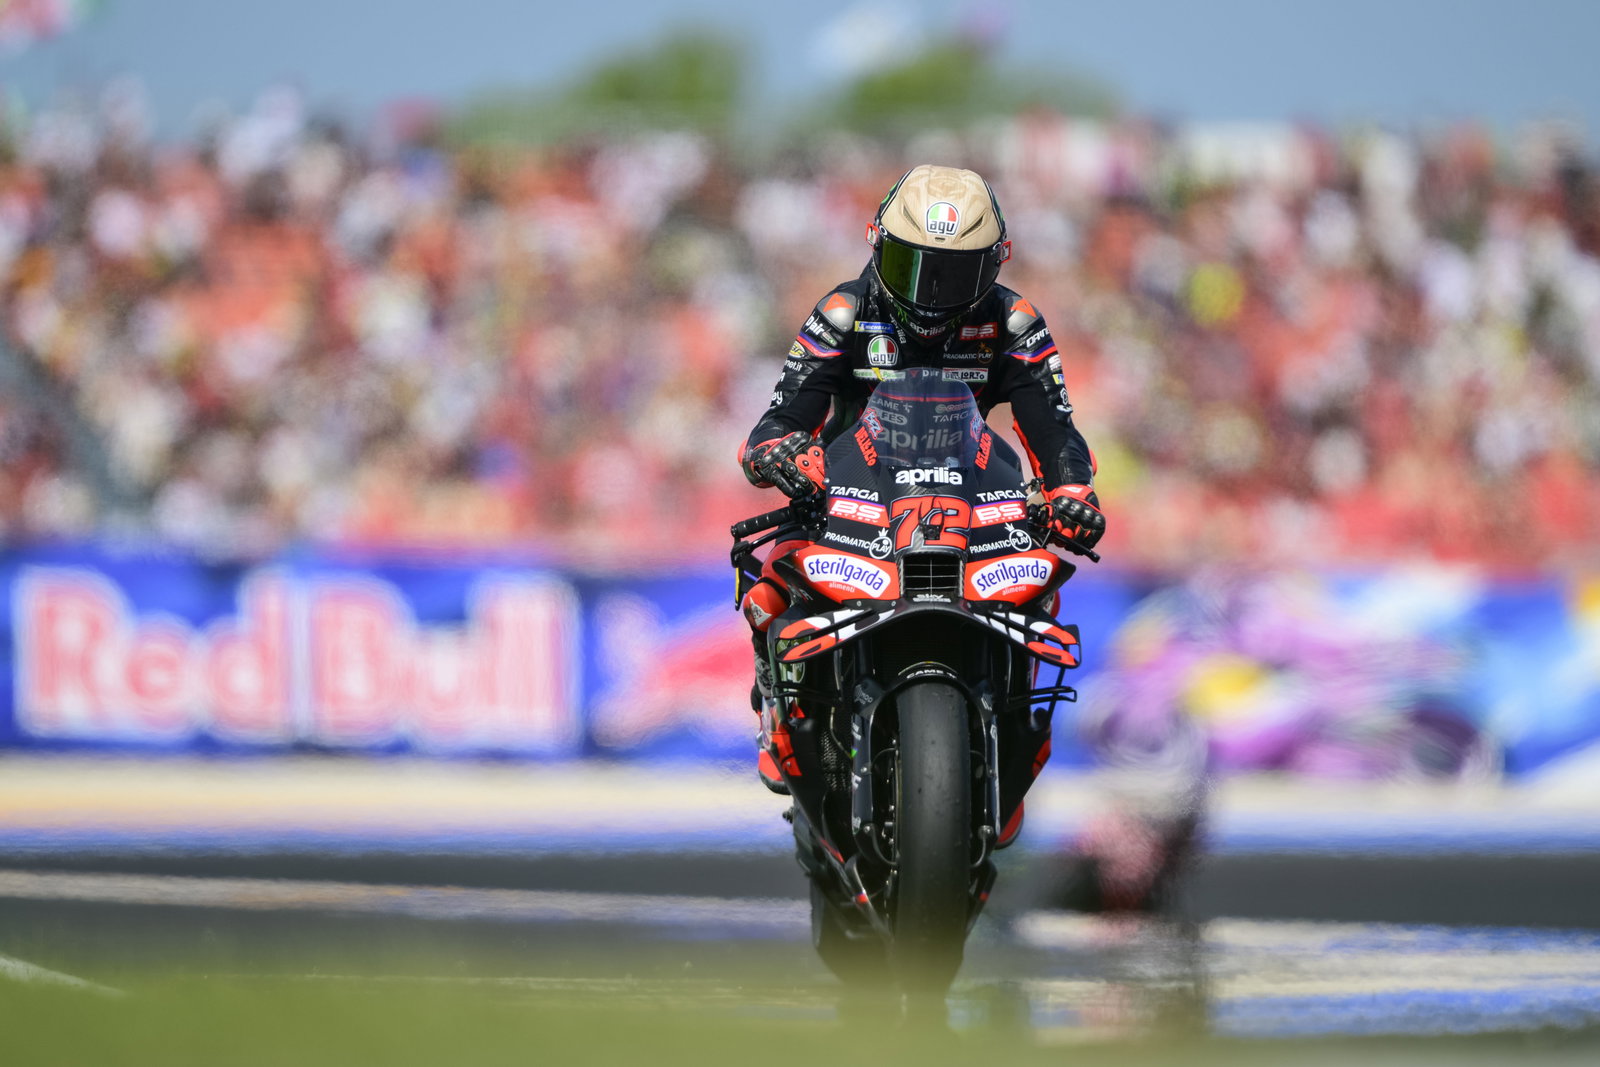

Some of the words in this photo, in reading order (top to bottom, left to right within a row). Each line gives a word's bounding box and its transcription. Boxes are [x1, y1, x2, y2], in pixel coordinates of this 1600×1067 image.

[909, 321, 946, 337] aprilia
[943, 352, 977, 360] PRAGMATIC
[978, 351, 993, 359] PLAY
[877, 428, 963, 450] aprilia
[895, 466, 963, 486] aprilia
[829, 486, 879, 502] TARGA
[976, 489, 1026, 502] TARGA
[831, 500, 884, 519] BS
[975, 503, 1023, 521] BS
[889, 494, 973, 555] 72
[824, 531, 871, 549] PRAGMATIC
[871, 543, 891, 553] PLAY
[969, 540, 1011, 554] PRAGMATIC
[1012, 536, 1029, 545] PLAY
[808, 557, 884, 591] sterilgarda
[976, 560, 1048, 592] sterilgarda
[828, 581, 856, 593] alimenti
[1002, 585, 1027, 596] alimenti
